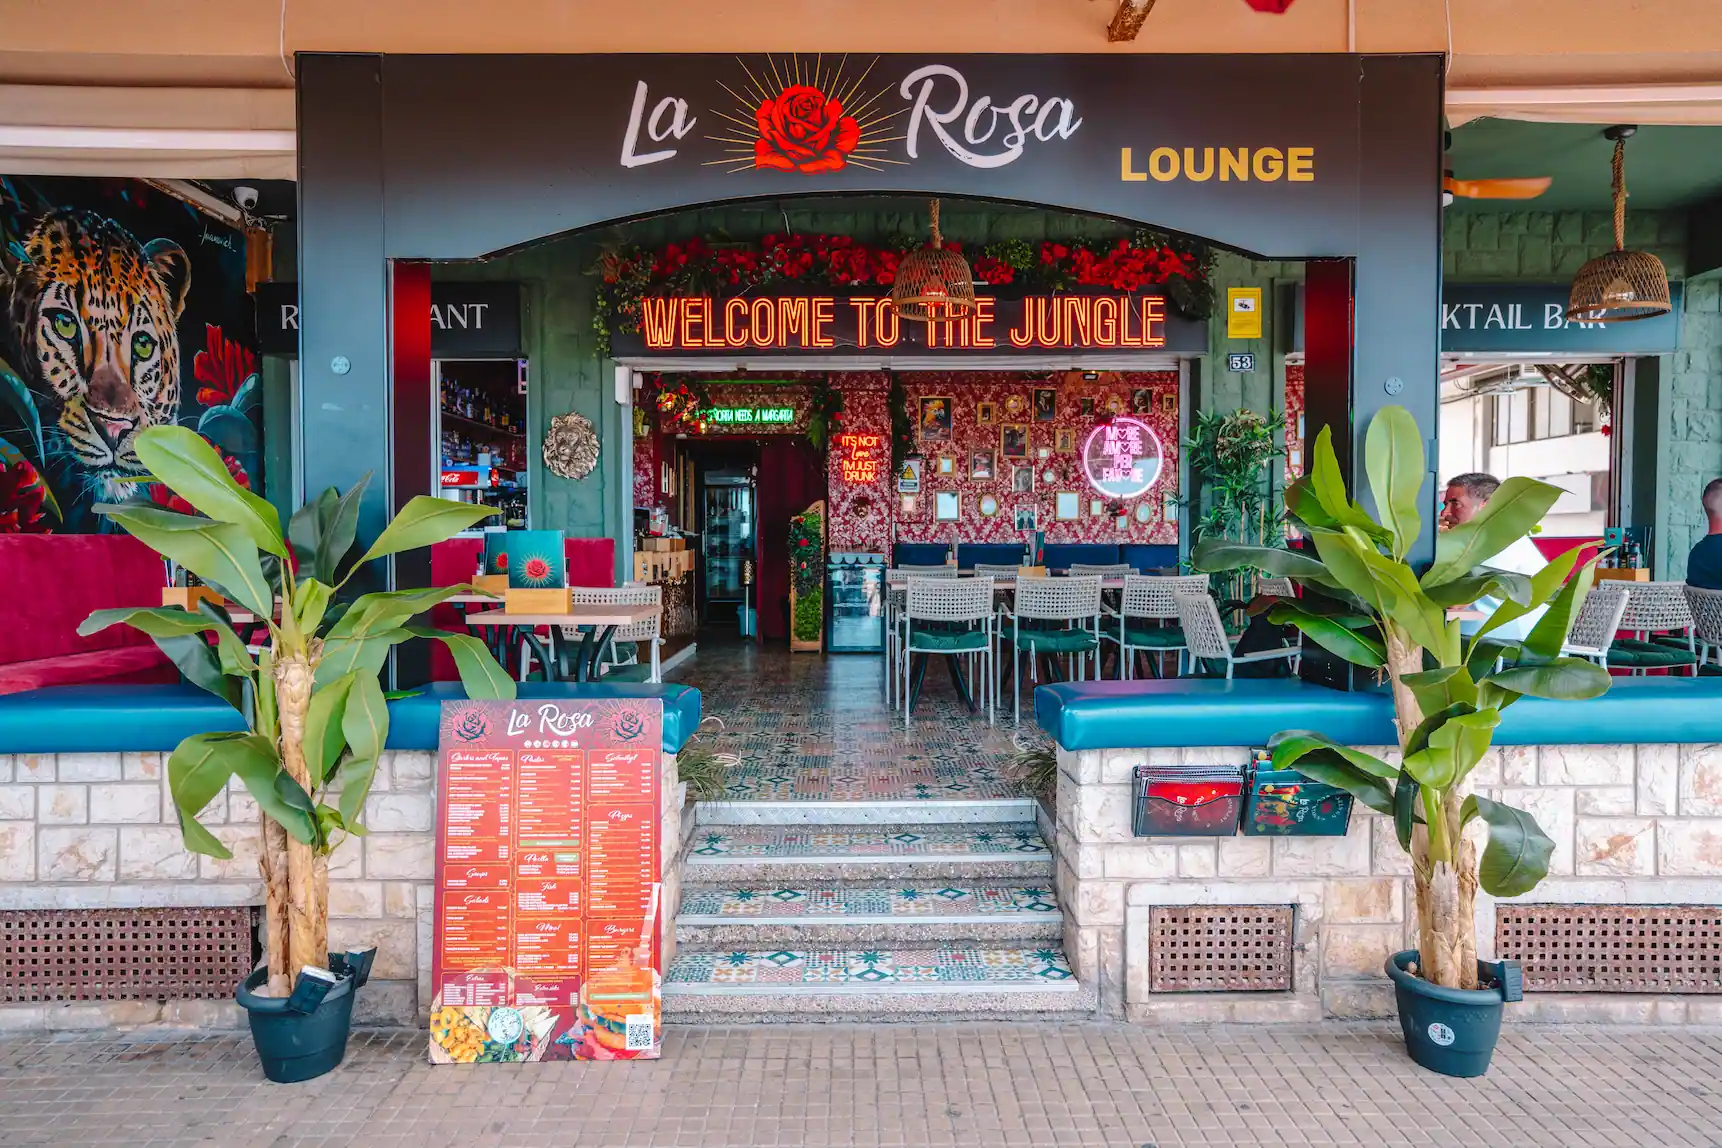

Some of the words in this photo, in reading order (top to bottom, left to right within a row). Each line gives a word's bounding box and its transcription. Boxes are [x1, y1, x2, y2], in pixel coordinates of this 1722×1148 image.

[620, 79, 698, 168] La
[900, 64, 1083, 168] Rosa
[1120, 147, 1314, 182] LOUNGE
[281, 304, 299, 330] R
[643, 297, 834, 347] WELCOME
[850, 297, 899, 347] TO
[918, 297, 995, 347] THE
[1010, 297, 1165, 346] JUNGLE
[1442, 303, 1532, 330] KTAIL
[1232, 356, 1251, 369] 53
[858, 436, 879, 446] NOT
[844, 471, 876, 481] DRUNK
[856, 460, 877, 471] JUST
[507, 708, 531, 736] La
[538, 704, 594, 736] Rosa
